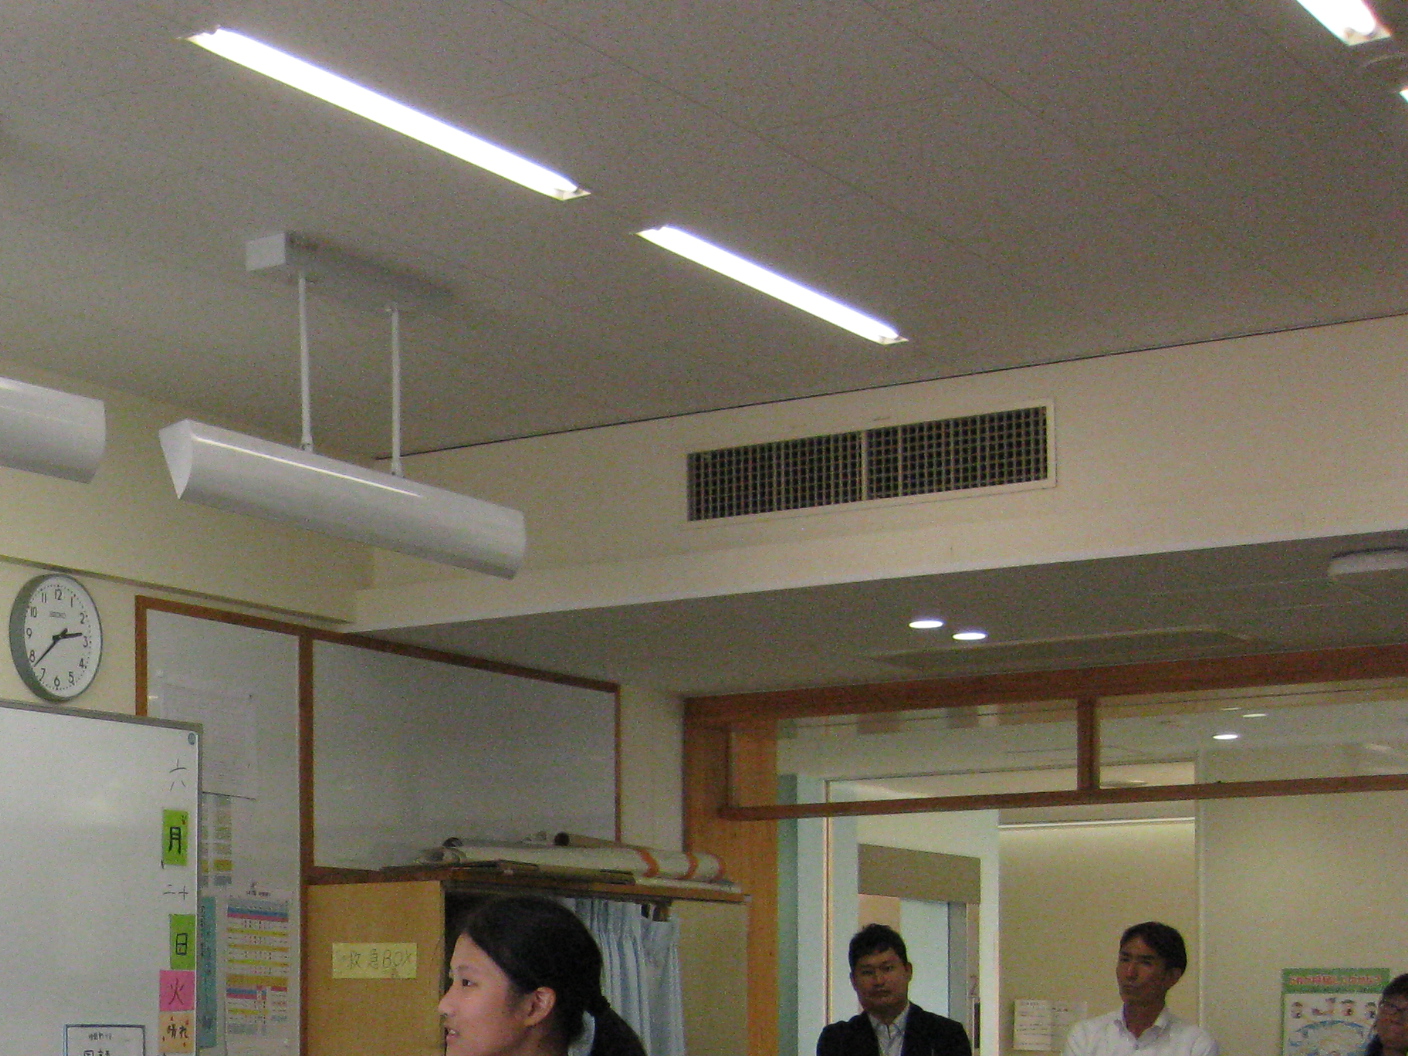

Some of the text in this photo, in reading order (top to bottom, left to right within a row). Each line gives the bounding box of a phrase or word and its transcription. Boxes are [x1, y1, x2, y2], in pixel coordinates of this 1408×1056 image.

[41, 592, 48, 604] 11
[54, 588, 63, 601] 12
[30, 606, 86, 625] 10 2
[26, 627, 89, 648] 9 3
[29, 650, 86, 669] 8 4
[39, 667, 75, 684] 7 5
[53, 675, 61, 688] 6
[168, 826, 182, 855] 月
[175, 932, 188, 956] 日
[167, 978, 185, 1006] 火
